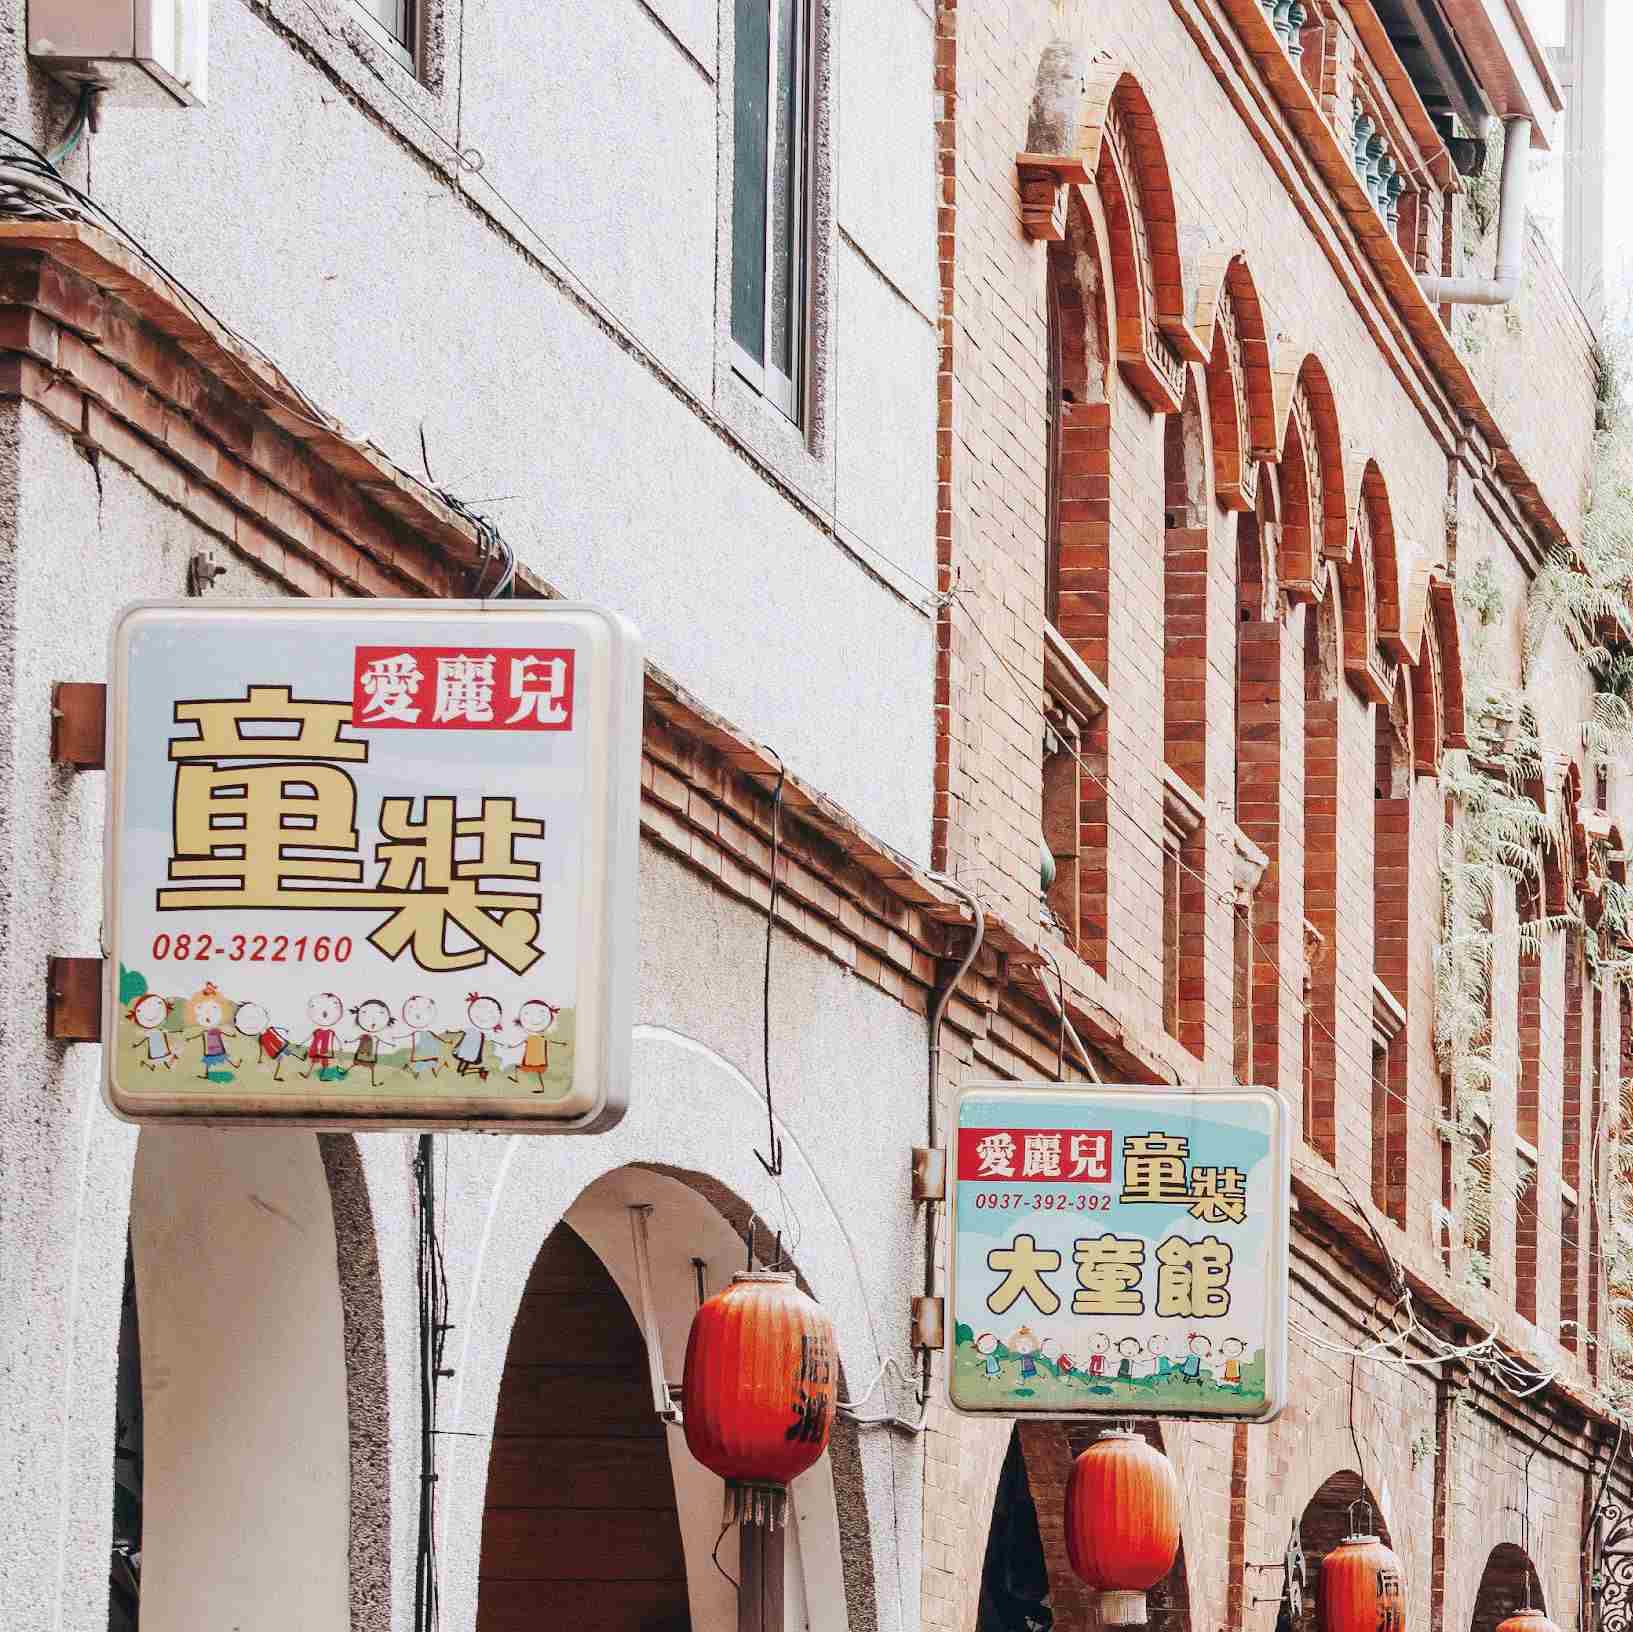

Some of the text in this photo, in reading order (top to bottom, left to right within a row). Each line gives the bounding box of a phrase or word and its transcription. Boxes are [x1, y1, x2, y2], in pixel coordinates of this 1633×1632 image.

[359, 653, 568, 726] 愛麗兒
[156, 685, 546, 976] 童裝
[152, 934, 353, 964] 082-322160
[975, 1132, 1108, 1179] 愛麗兒
[1119, 1131, 1248, 1225] 童裝
[975, 1193, 1113, 1212] 0937-392-392
[985, 1233, 1233, 1319] 大童館
